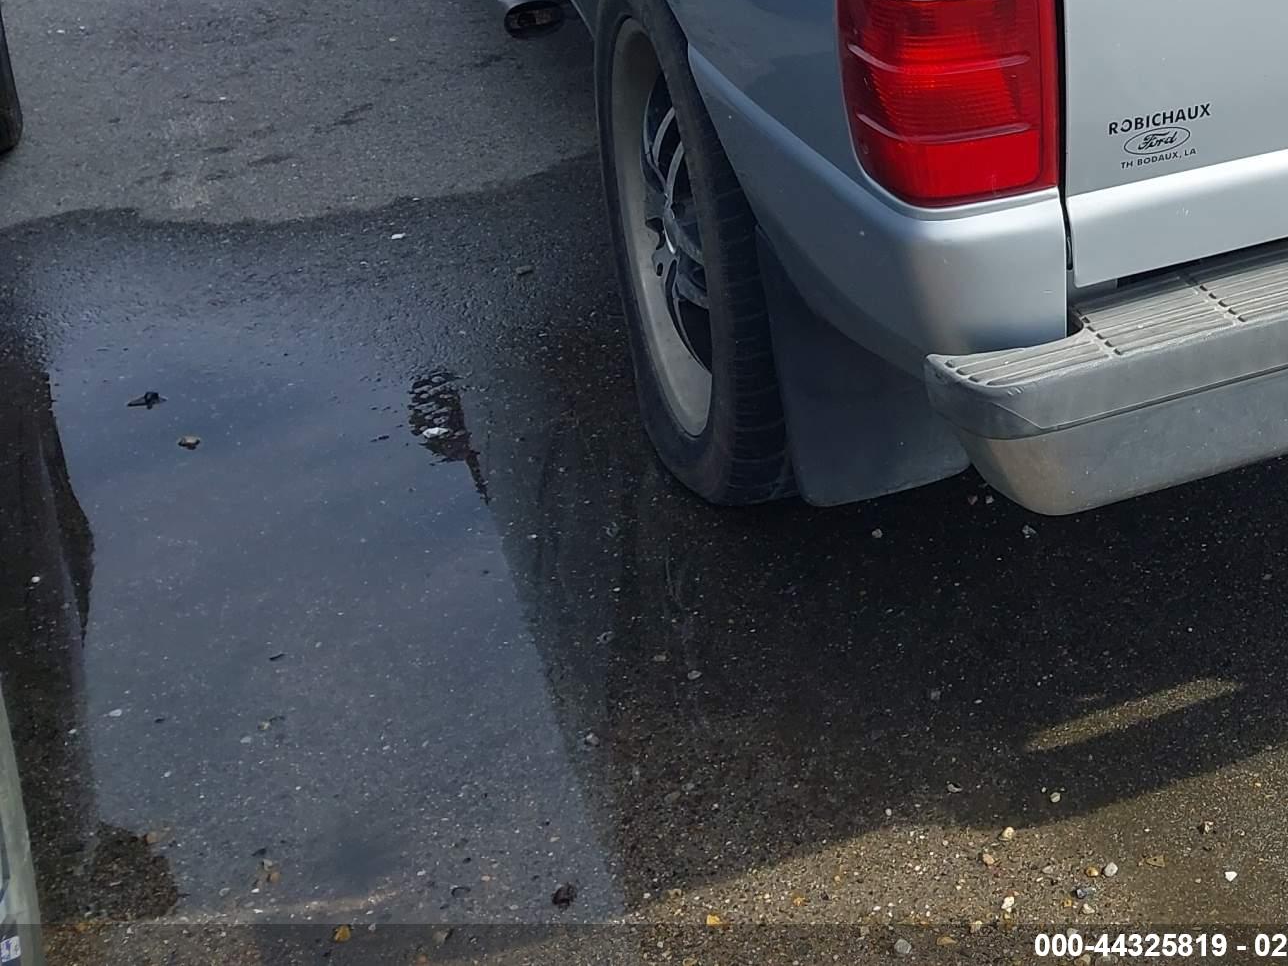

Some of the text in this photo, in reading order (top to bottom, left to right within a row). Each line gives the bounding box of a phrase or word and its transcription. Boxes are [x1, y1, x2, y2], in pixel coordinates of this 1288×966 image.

[1108, 102, 1211, 136] ROBICHAUX
[1137, 130, 1178, 151] Ford
[1184, 147, 1197, 157] LA
